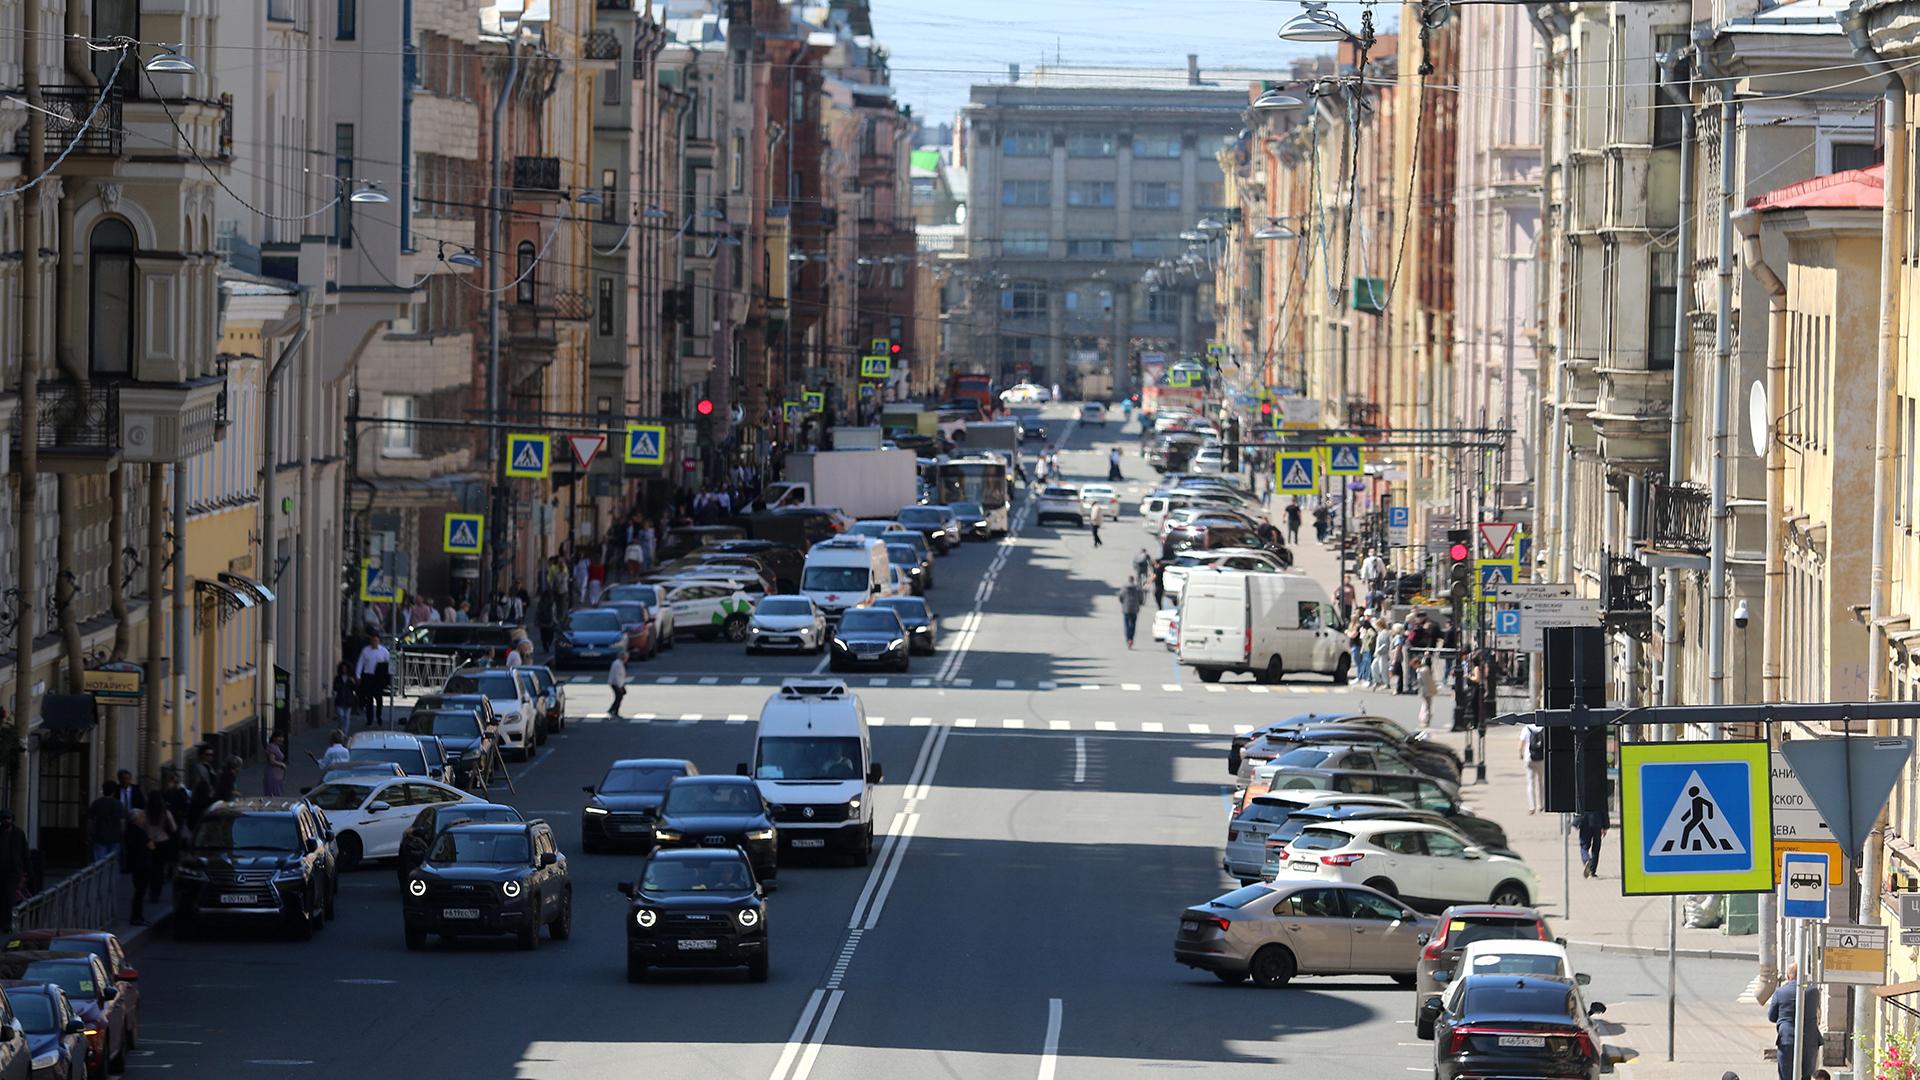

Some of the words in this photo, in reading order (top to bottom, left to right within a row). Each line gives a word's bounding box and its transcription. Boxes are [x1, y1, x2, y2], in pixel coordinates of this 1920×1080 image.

[1394, 509, 1406, 525] P
[1503, 613, 1518, 632] P
[86, 681, 134, 691] НОТАРИУС
[1773, 795, 1804, 805] СКОГО
[1774, 825, 1796, 836] ЕВА
[1844, 936, 1854, 946] А
